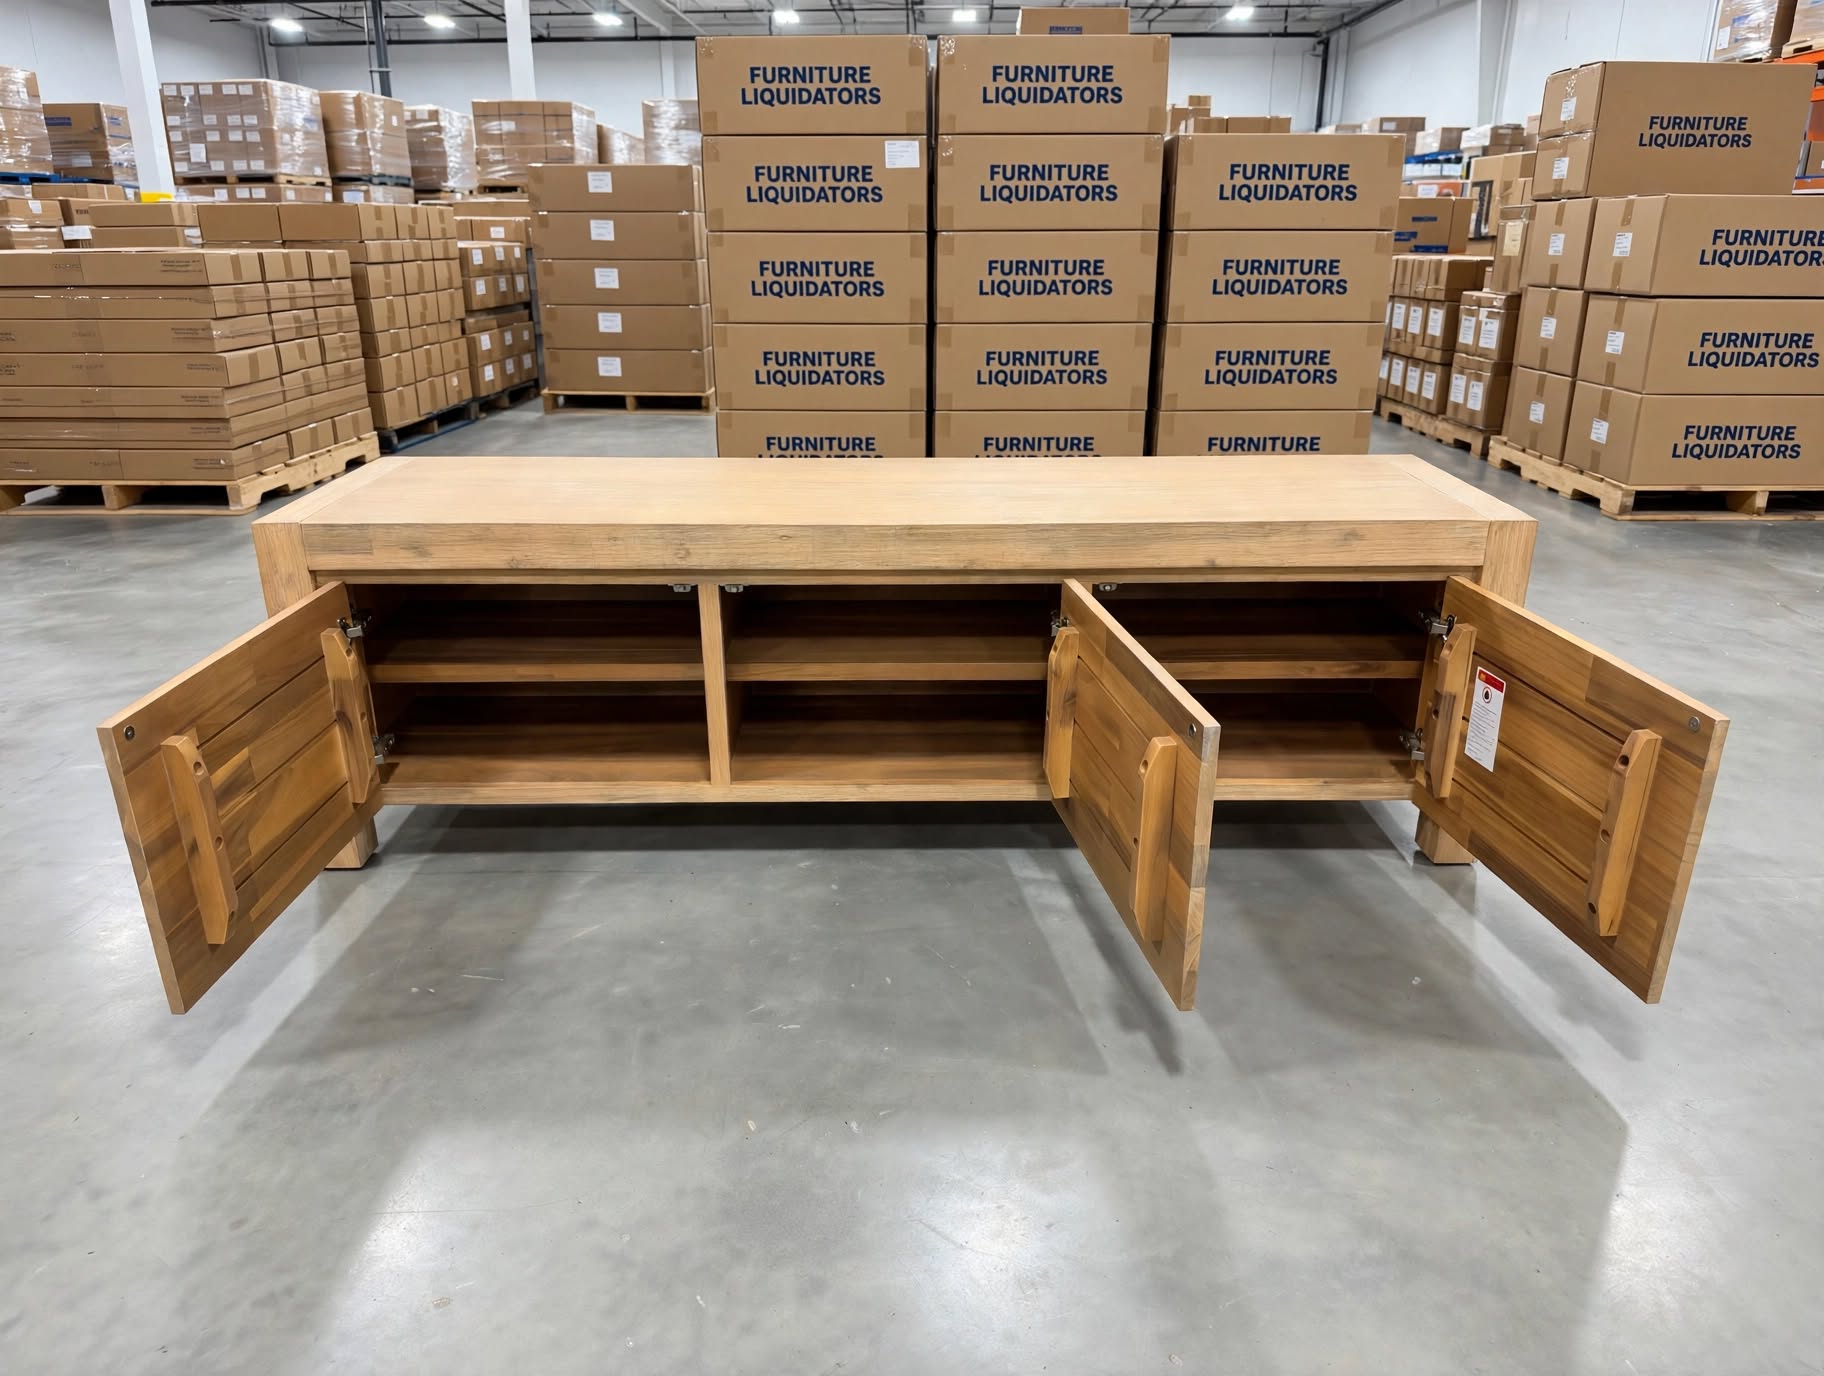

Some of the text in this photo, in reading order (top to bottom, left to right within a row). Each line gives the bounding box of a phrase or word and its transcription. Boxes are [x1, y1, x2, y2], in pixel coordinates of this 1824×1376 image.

[750, 66, 870, 84] FURNITURE
[992, 65, 1114, 83] FURNITURE
[741, 87, 880, 106] LIQUIDATORS
[983, 86, 1123, 105] LIQUIDATORS
[1649, 116, 1747, 131] FURNITURE
[1639, 133, 1752, 148] LIQUIDATORS
[755, 165, 872, 182] FURNITURE
[990, 164, 1109, 181] FURNITURE
[1230, 164, 1350, 181] FURNITURE
[746, 186, 883, 204] LIQUIDATORS
[980, 185, 1118, 203] LIQUIDATORS
[1219, 184, 1357, 202] LIQUIDATORS
[1712, 229, 1824, 247] FURNITURE
[1699, 249, 1824, 267] LIQUIDATOR
[759, 261, 874, 277] FURNITURE
[988, 259, 1104, 276] FURNITURE
[1223, 259, 1340, 276] FURNITURE
[751, 280, 884, 298] LIQUIDATORS
[979, 279, 1112, 297] LIQUIDATORS
[1212, 279, 1347, 296] LIQUIDATORS
[1700, 332, 1814, 349] FURNITURE
[763, 351, 875, 367] FURNITURE
[986, 350, 1099, 366] FURNITURE
[1215, 350, 1329, 366] FURNITURE
[1688, 351, 1819, 368] LIQUIDATORS
[755, 370, 885, 386] LIQUIDATORS
[977, 369, 1107, 387] LIQUIDATORS
[1205, 369, 1337, 385] LIQUIDATORS
[1684, 425, 1795, 441] FURNITURE
[766, 436, 876, 452] FURNITURE
[984, 437, 1093, 452] FURNITURE
[1208, 436, 1320, 452] FURNITURE
[1672, 443, 1801, 459] LIQUIDATORS
